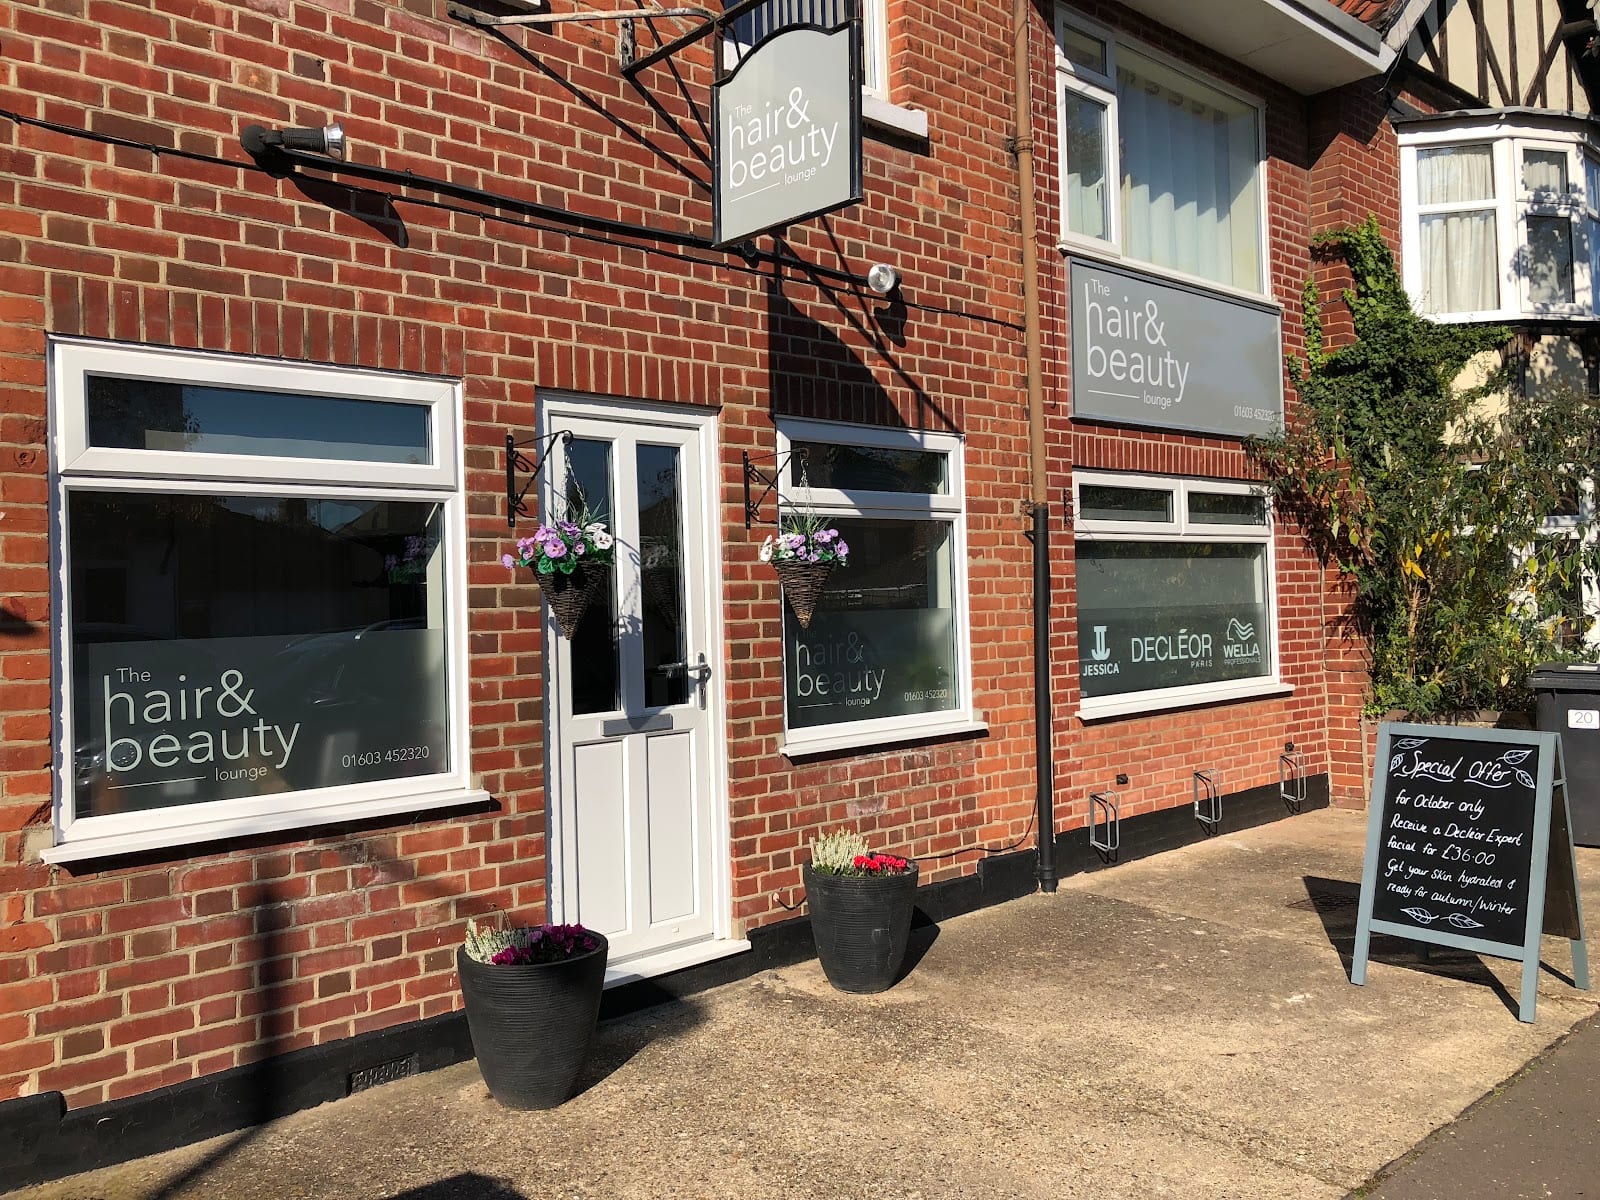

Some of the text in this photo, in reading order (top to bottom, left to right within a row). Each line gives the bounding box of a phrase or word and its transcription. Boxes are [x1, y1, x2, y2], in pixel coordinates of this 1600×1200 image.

[729, 87, 810, 150] hair&
[735, 104, 752, 118] The
[729, 121, 839, 189] beauty
[784, 166, 817, 186] lounge
[1091, 278, 1111, 296] The
[1085, 283, 1167, 346] hair&
[1087, 345, 1190, 403] beauty
[1143, 391, 1172, 410] lounge
[1234, 405, 1253, 418] 01603
[796, 632, 864, 666] hair&
[1131, 628, 1213, 663] DECLÉOR
[1223, 643, 1261, 658] WELLA
[1083, 663, 1120, 676] JESSICA
[1190, 660, 1214, 668] PARIS
[115, 667, 151, 684] The
[796, 665, 885, 700] beauty
[103, 669, 258, 725] hair&
[904, 689, 948, 702] 01603 452320
[1574, 711, 1593, 724] 20
[105, 717, 301, 773] beauty
[342, 745, 430, 769] 01603 452320
[1402, 750, 1512, 782] Special Offer
[215, 765, 268, 784] lounge
[1395, 789, 1485, 820] for October only
[1390, 813, 1428, 833] Receive
[1432, 828, 1441, 836] a
[1486, 828, 1523, 847] Expert
[1387, 835, 1417, 852] facial
[1422, 843, 1438, 856] for
[1384, 858, 1405, 877] Get
[1404, 864, 1429, 880] your
[1458, 870, 1502, 888] hydrated
[1386, 882, 1412, 898] ready
[1414, 886, 1428, 897] for
